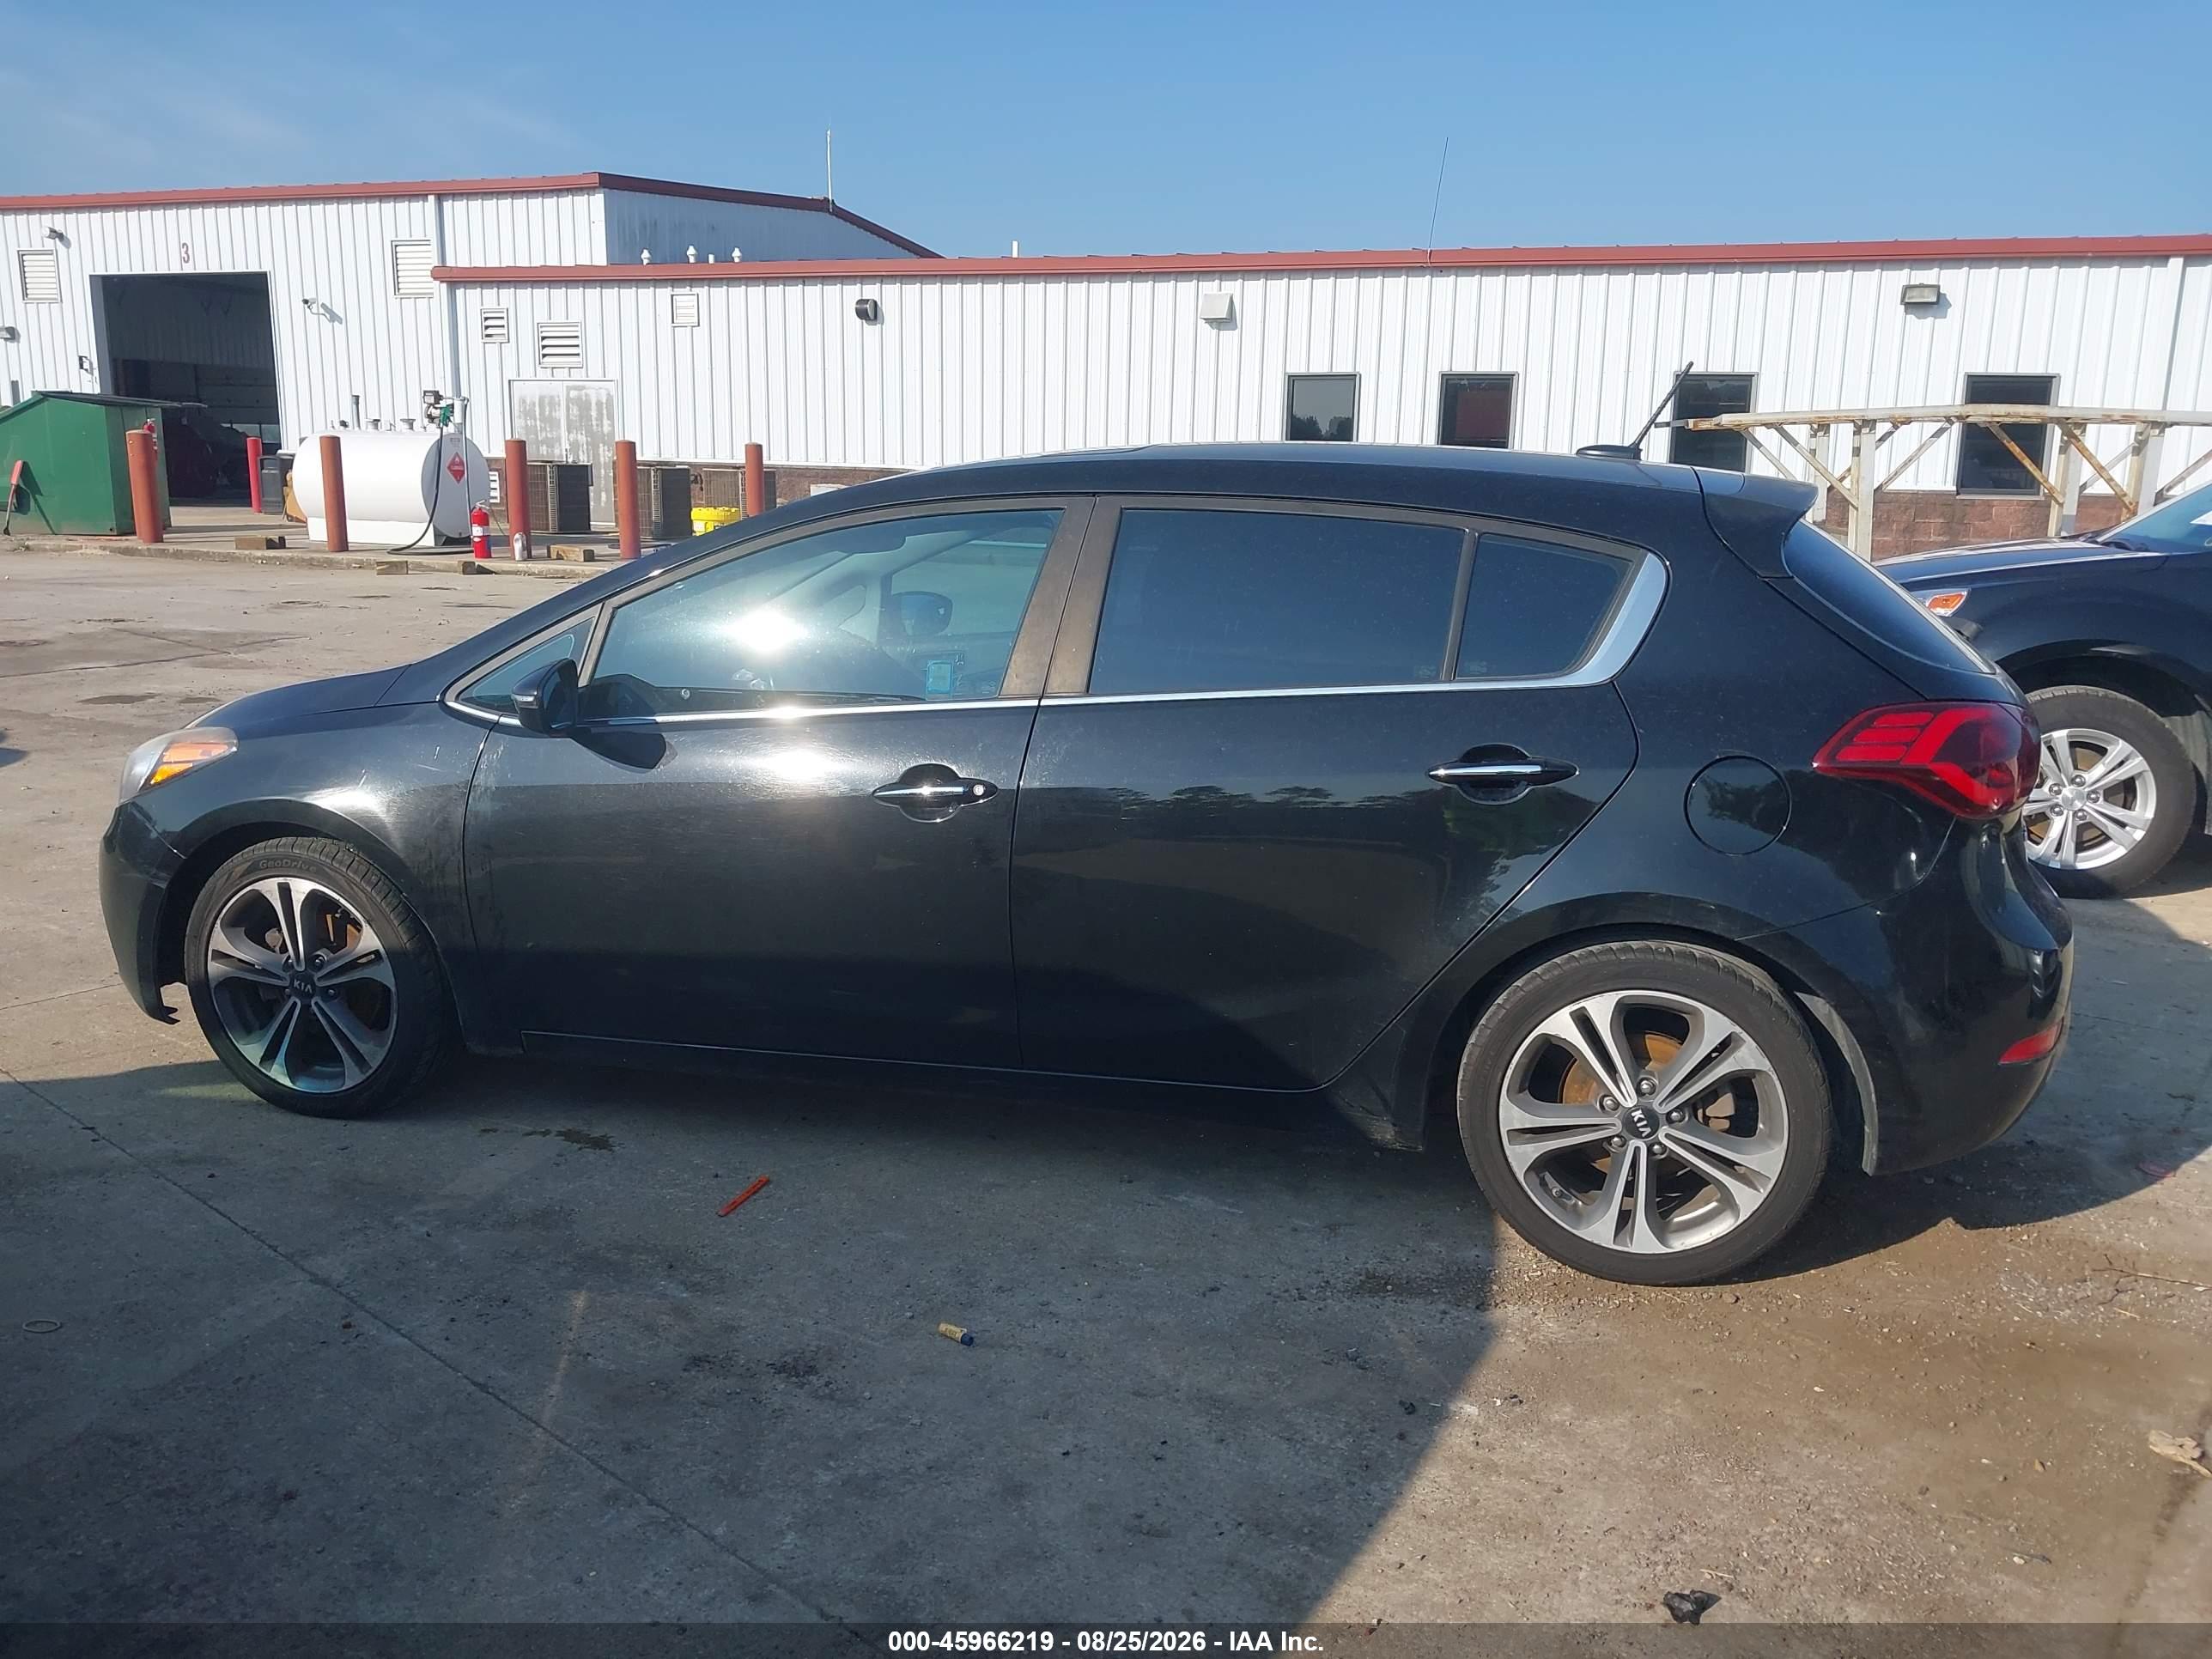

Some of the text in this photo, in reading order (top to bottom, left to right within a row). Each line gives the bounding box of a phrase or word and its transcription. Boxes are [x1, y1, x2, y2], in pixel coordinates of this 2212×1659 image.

[181, 241, 191, 264] 3
[294, 978, 313, 994] KIA
[1631, 1109, 1651, 1138] KIA
